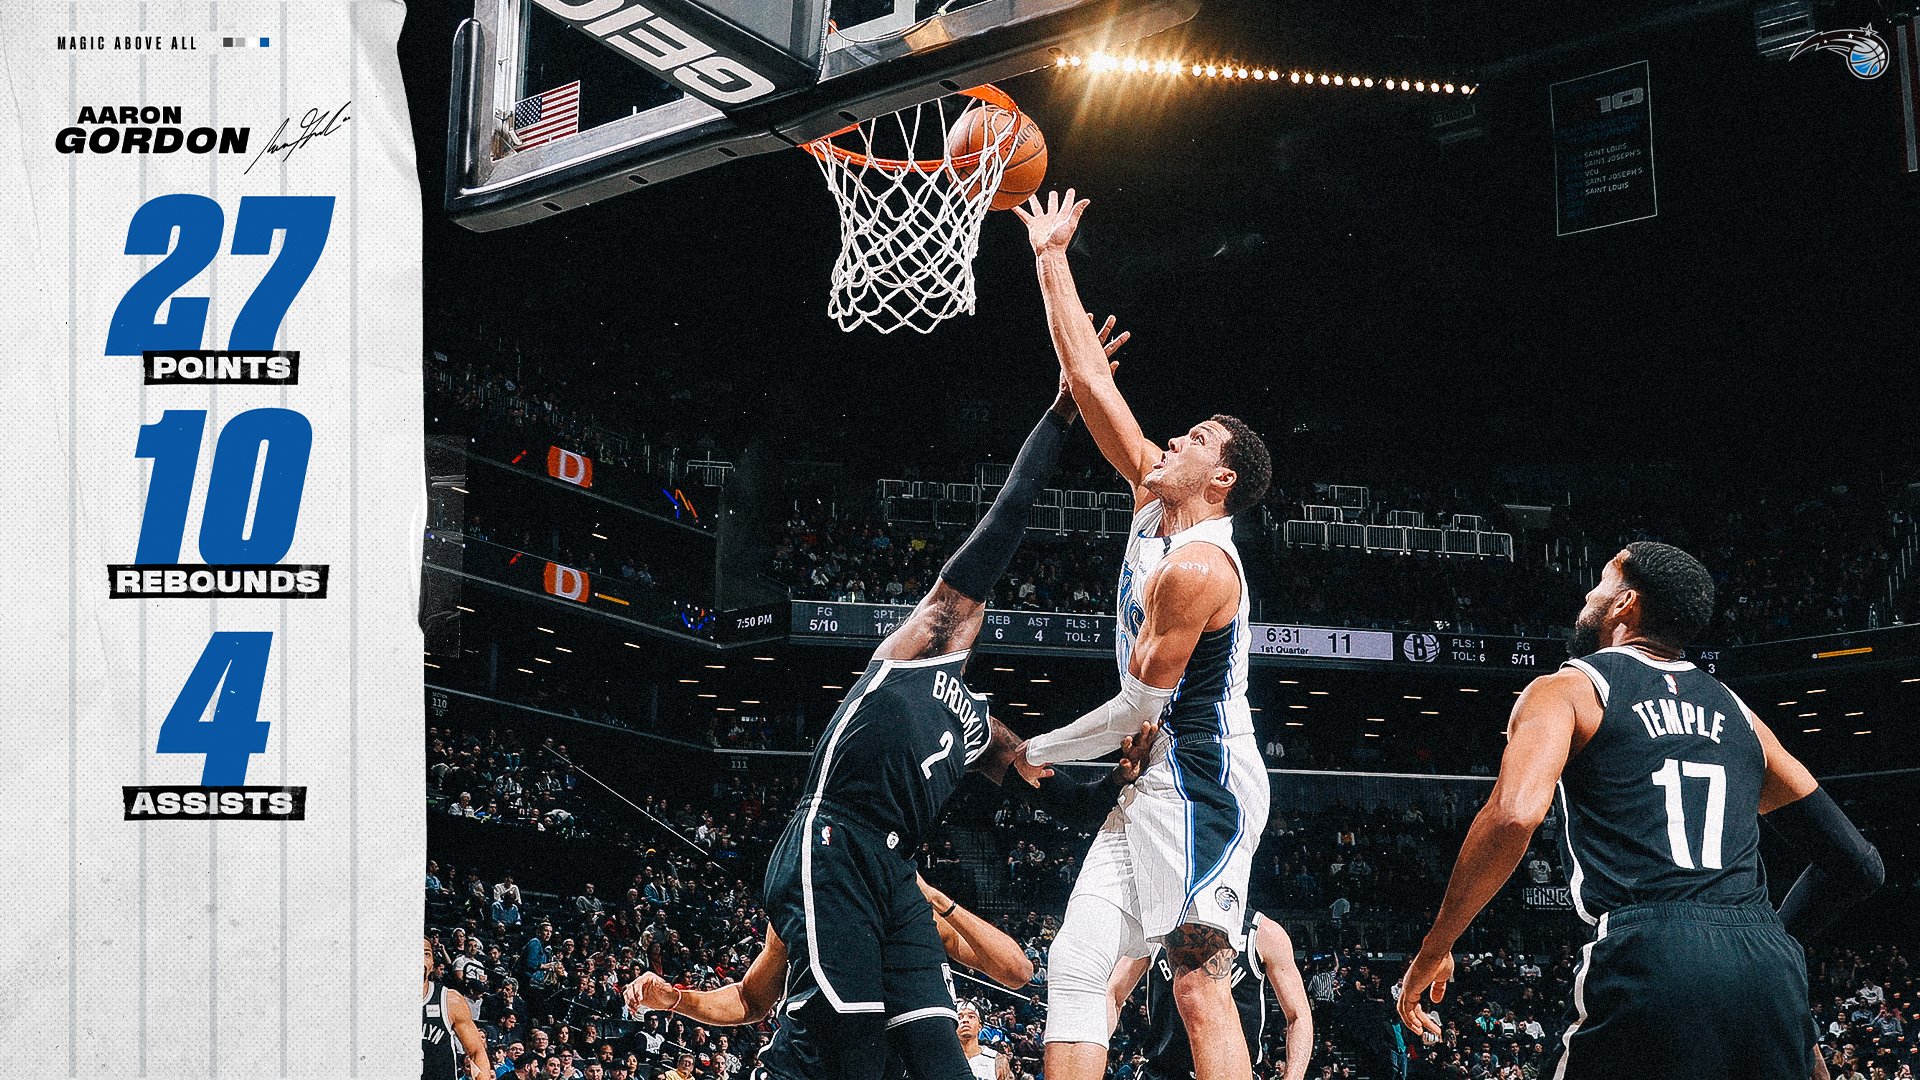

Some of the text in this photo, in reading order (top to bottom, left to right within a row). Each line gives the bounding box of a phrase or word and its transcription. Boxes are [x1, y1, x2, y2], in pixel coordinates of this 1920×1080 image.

[1584, 143, 1627, 158] SAINT LOUIS
[1584, 149, 1642, 168] SAINT JOSEPH'S
[1585, 168, 1599, 177] VCU
[1585, 167, 1643, 187] SAINT JOSEPH'S
[1585, 181, 1629, 196] SAINT LOUIS
[558, 450, 585, 484] D
[554, 564, 583, 601] D
[817, 606, 833, 617] FG
[873, 609, 895, 619] 3PT
[736, 614, 773, 630] 7:50 PM
[809, 619, 838, 632] 5/10
[987, 614, 1011, 626] REB
[1028, 617, 1050, 627] AST
[1066, 618, 1100, 630] FLS: 1
[995, 628, 1004, 640] 6
[1034, 630, 1044, 642] 4
[1065, 632, 1101, 644] TOL: 7
[1266, 627, 1301, 644] 6:31
[1259, 644, 1310, 655] 1st Quarter
[1327, 632, 1352, 655] 11
[1452, 638, 1485, 649] FLS: 1
[1516, 641, 1531, 651] FG
[1452, 651, 1487, 663] TOL: 6
[1511, 653, 1536, 666] 5/11
[1700, 651, 1720, 660] AST
[1708, 663, 1716, 674] 3
[932, 671, 983, 765] BROOKLYN
[1631, 698, 1726, 745] TEMPLE
[920, 730, 954, 780] 2
[1651, 758, 1727, 870] 17
